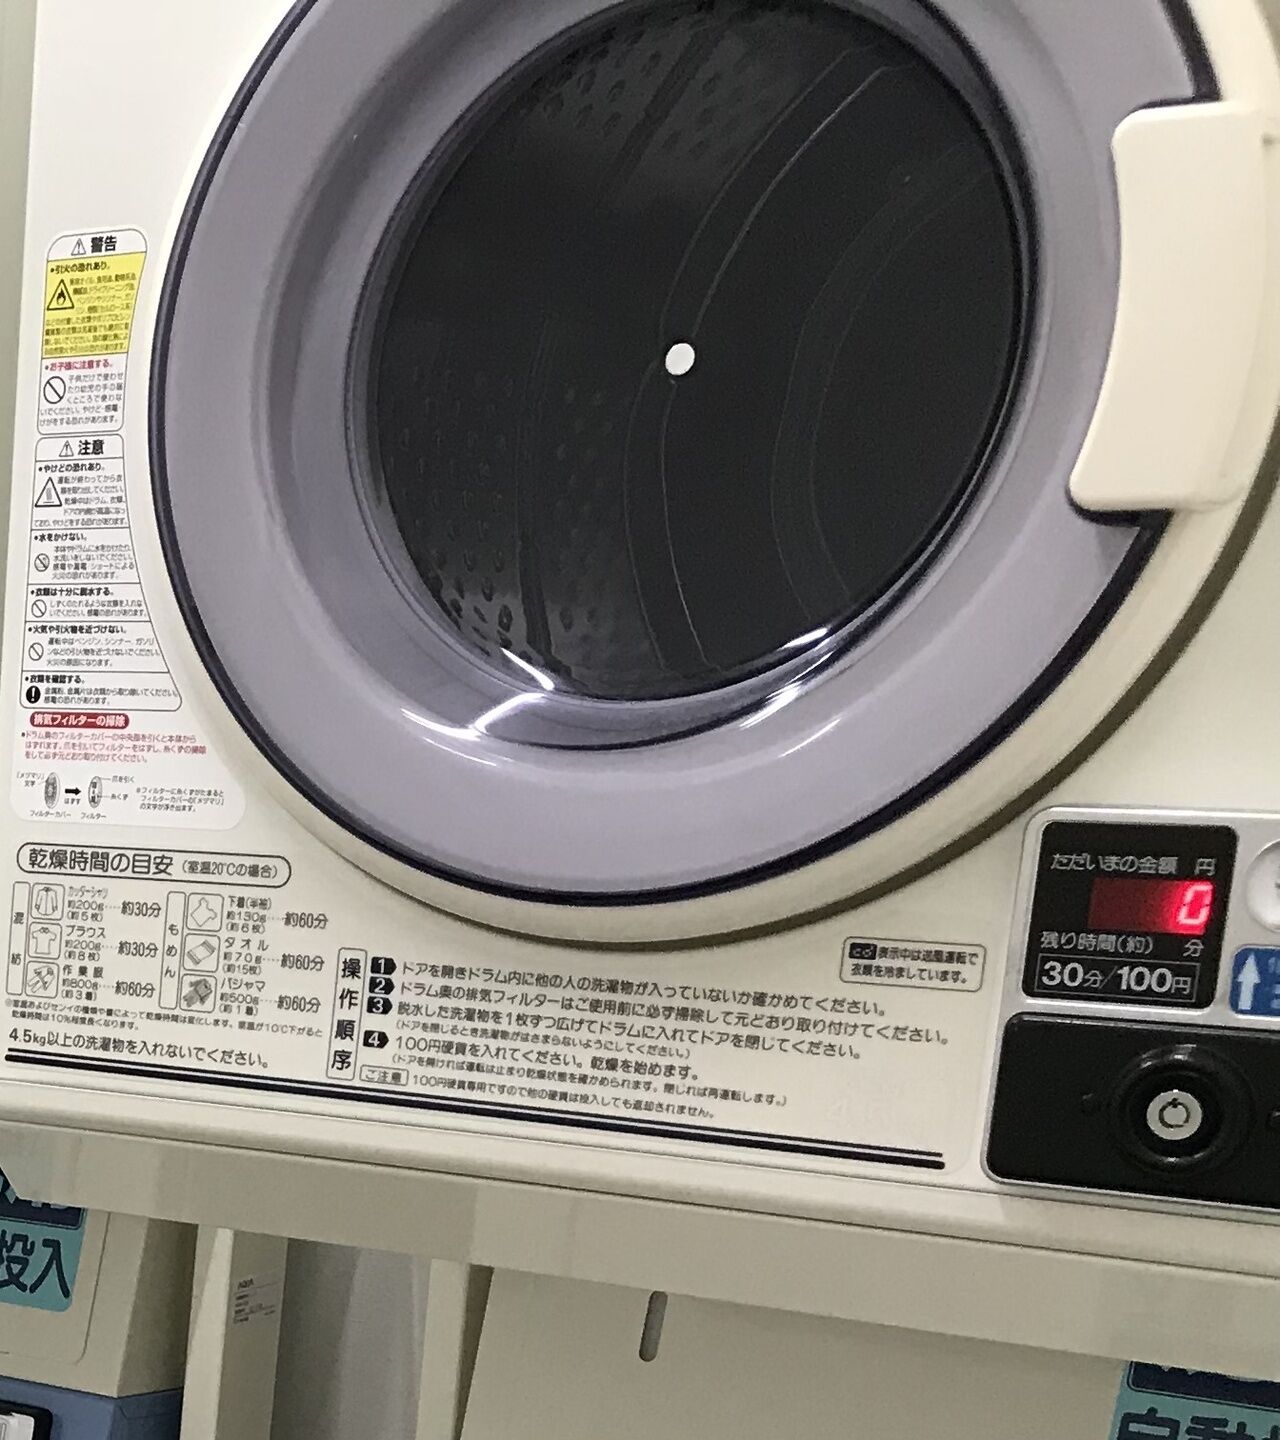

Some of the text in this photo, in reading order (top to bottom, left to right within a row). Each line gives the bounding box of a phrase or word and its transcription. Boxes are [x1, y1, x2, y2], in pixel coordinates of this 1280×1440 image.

[90, 235, 117, 253] 警告
[77, 439, 105, 456] 注意
[32, 713, 127, 727] 排気フィルターの掃除
[27, 848, 175, 876] 乾燥時間の目安
[1049, 852, 1217, 877] ただいまの金額 円
[120, 901, 163, 918] 約30分
[1176, 880, 1215, 927] 0
[283, 911, 329, 930] 約60分
[65, 924, 108, 939] ブラウス
[116, 940, 160, 959] 約30分
[163, 924, 181, 979] もめん
[223, 936, 270, 952] タオル
[1040, 931, 1205, 957] 残り時間(約) 分
[280, 953, 326, 971] 約60分
[219, 977, 267, 992] パジャマ
[1041, 960, 1193, 995] 30分/100円
[114, 979, 157, 999] 約60分
[276, 994, 322, 1014] 約60分
[330, 956, 363, 1072] 操作順序
[8, 1027, 270, 1069] 4.5kg以上の洗濯物を入れないでください。
